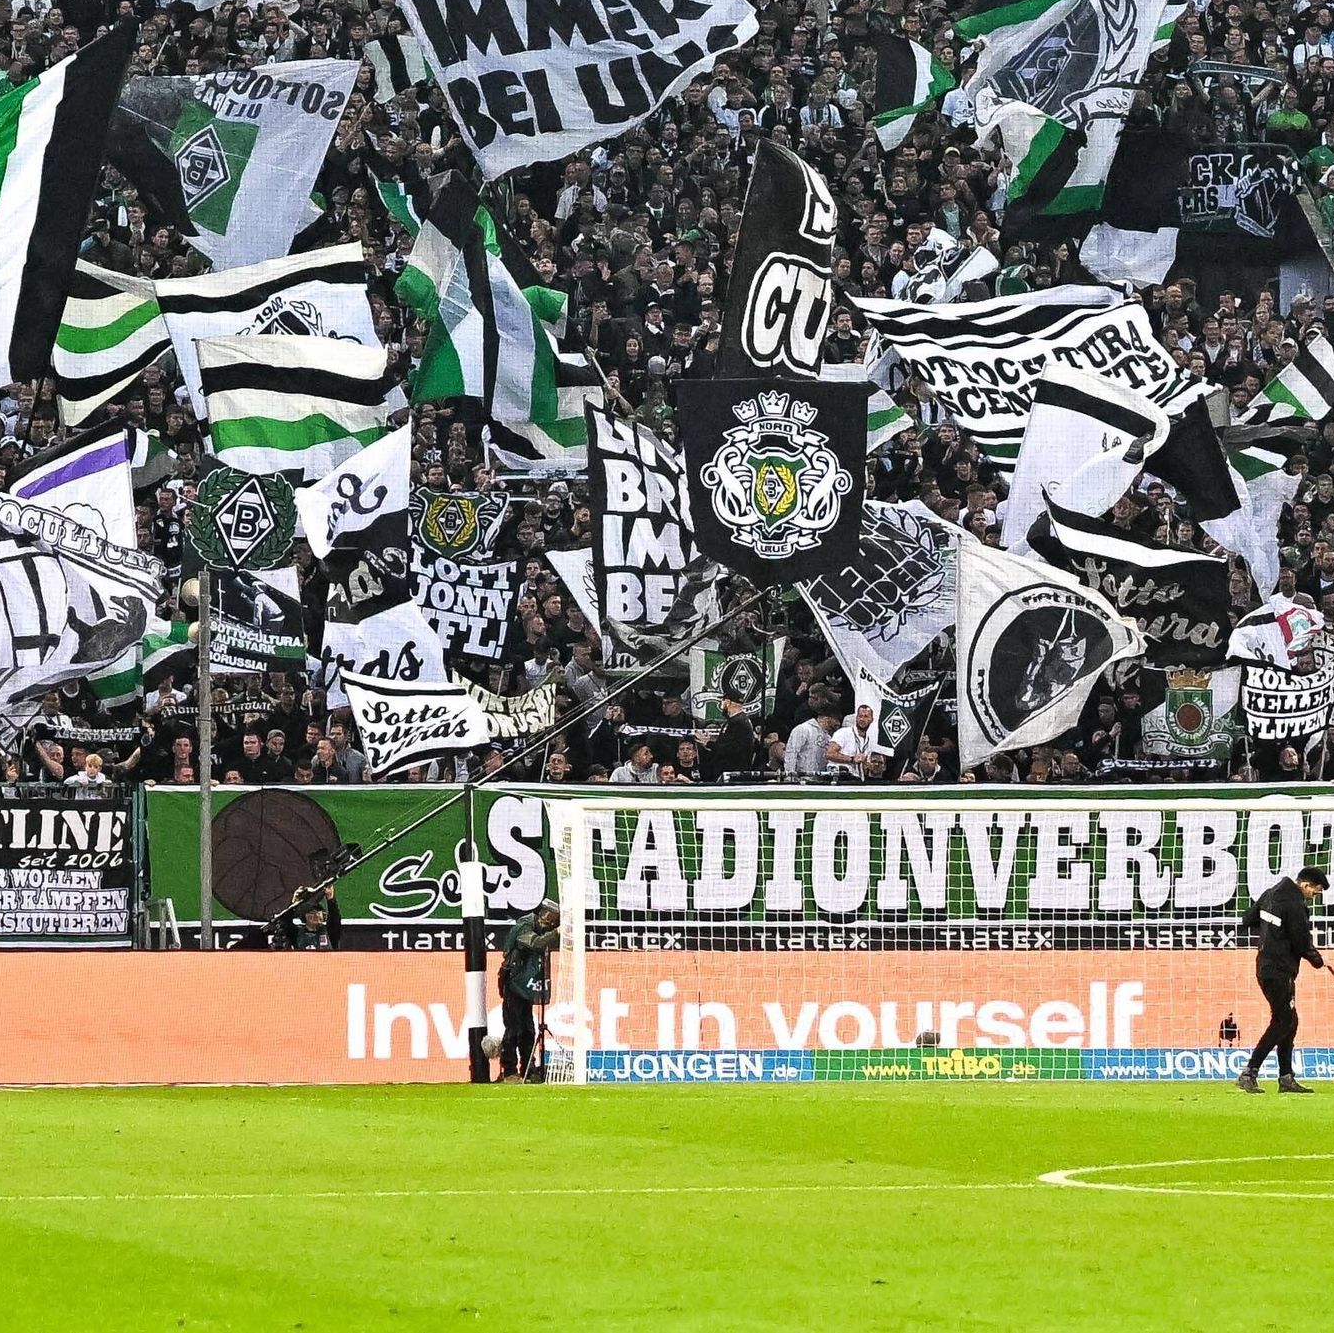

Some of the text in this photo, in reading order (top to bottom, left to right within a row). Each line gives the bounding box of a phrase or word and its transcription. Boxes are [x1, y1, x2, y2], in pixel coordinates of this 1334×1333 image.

[448, 68, 565, 150] BEI
[757, 422, 794, 435] NORD
[410, 542, 517, 589] LOTT
[1246, 665, 1334, 691] KÖLNER
[1247, 688, 1331, 714] KELLER
[1247, 708, 1328, 740] FLUTEN
[18, 853, 57, 868] seit
[65, 853, 123, 868] 2006
[10, 869, 101, 889] WOLLEN
[21, 887, 129, 911] KÄMPFEN
[657, 979, 737, 1051] in
[614, 1052, 763, 1080] JONGEN
